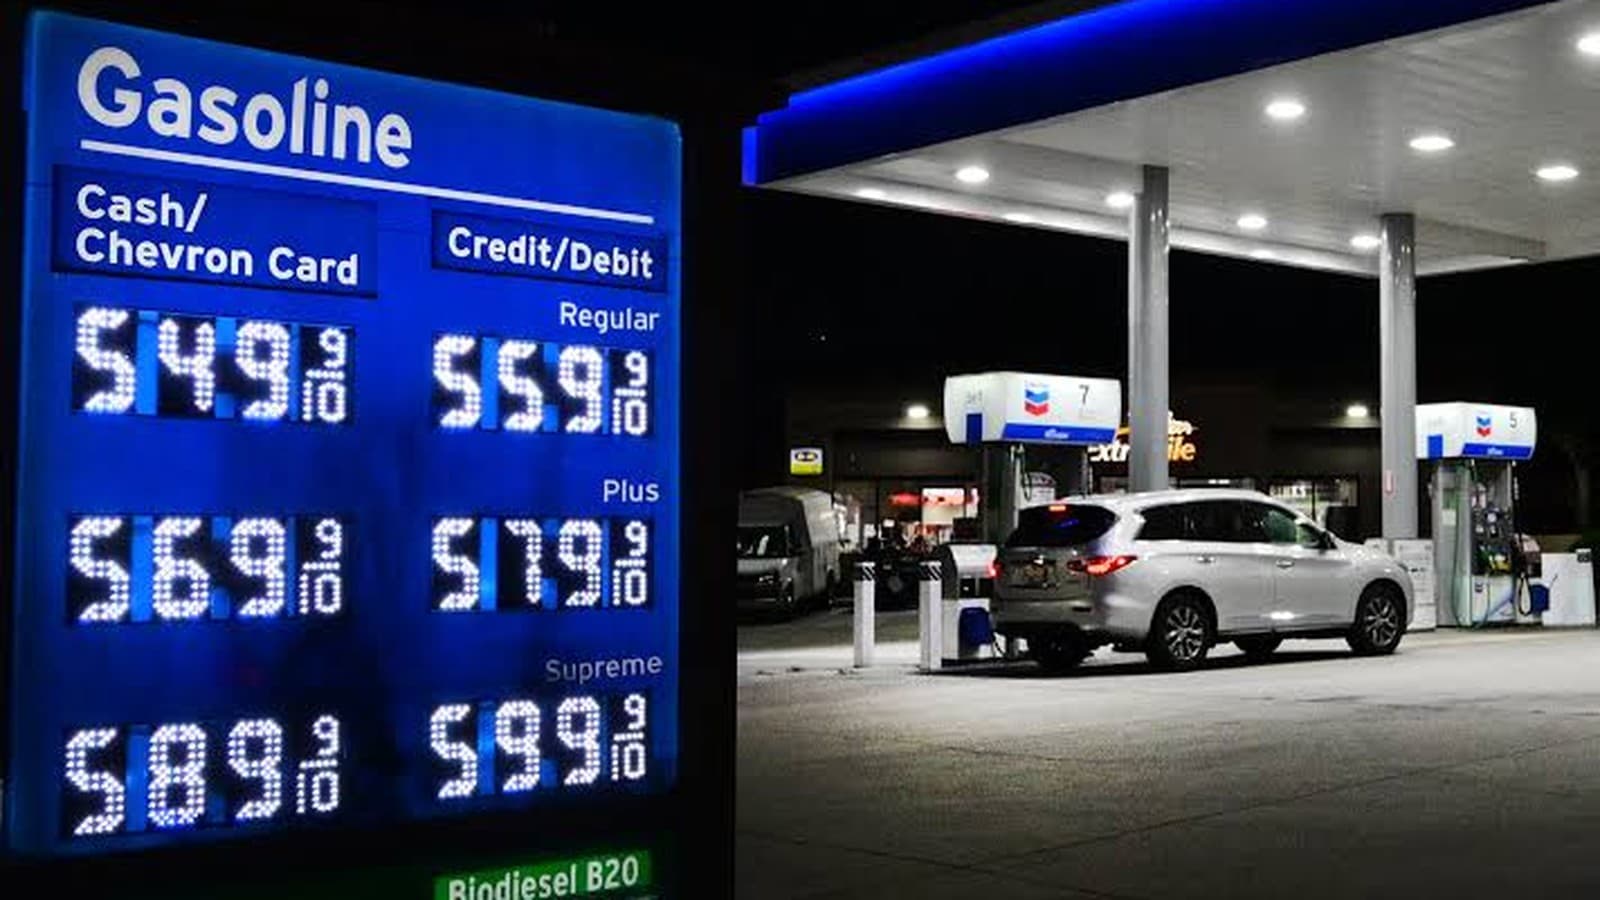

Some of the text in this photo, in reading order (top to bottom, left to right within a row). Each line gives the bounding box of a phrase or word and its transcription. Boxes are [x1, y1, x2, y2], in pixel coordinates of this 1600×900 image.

[77, 47, 412, 169] Gasoline
[77, 184, 208, 232] Cash/
[76, 227, 358, 285] Chevron Card
[448, 226, 653, 279] Credit/Debit
[560, 301, 660, 334] Regular
[1079, 384, 1090, 405] 7
[1509, 412, 1518, 428] 5
[603, 479, 659, 503] Plus
[545, 656, 663, 685] Supreme
[448, 856, 639, 900] Biodiesel B20
